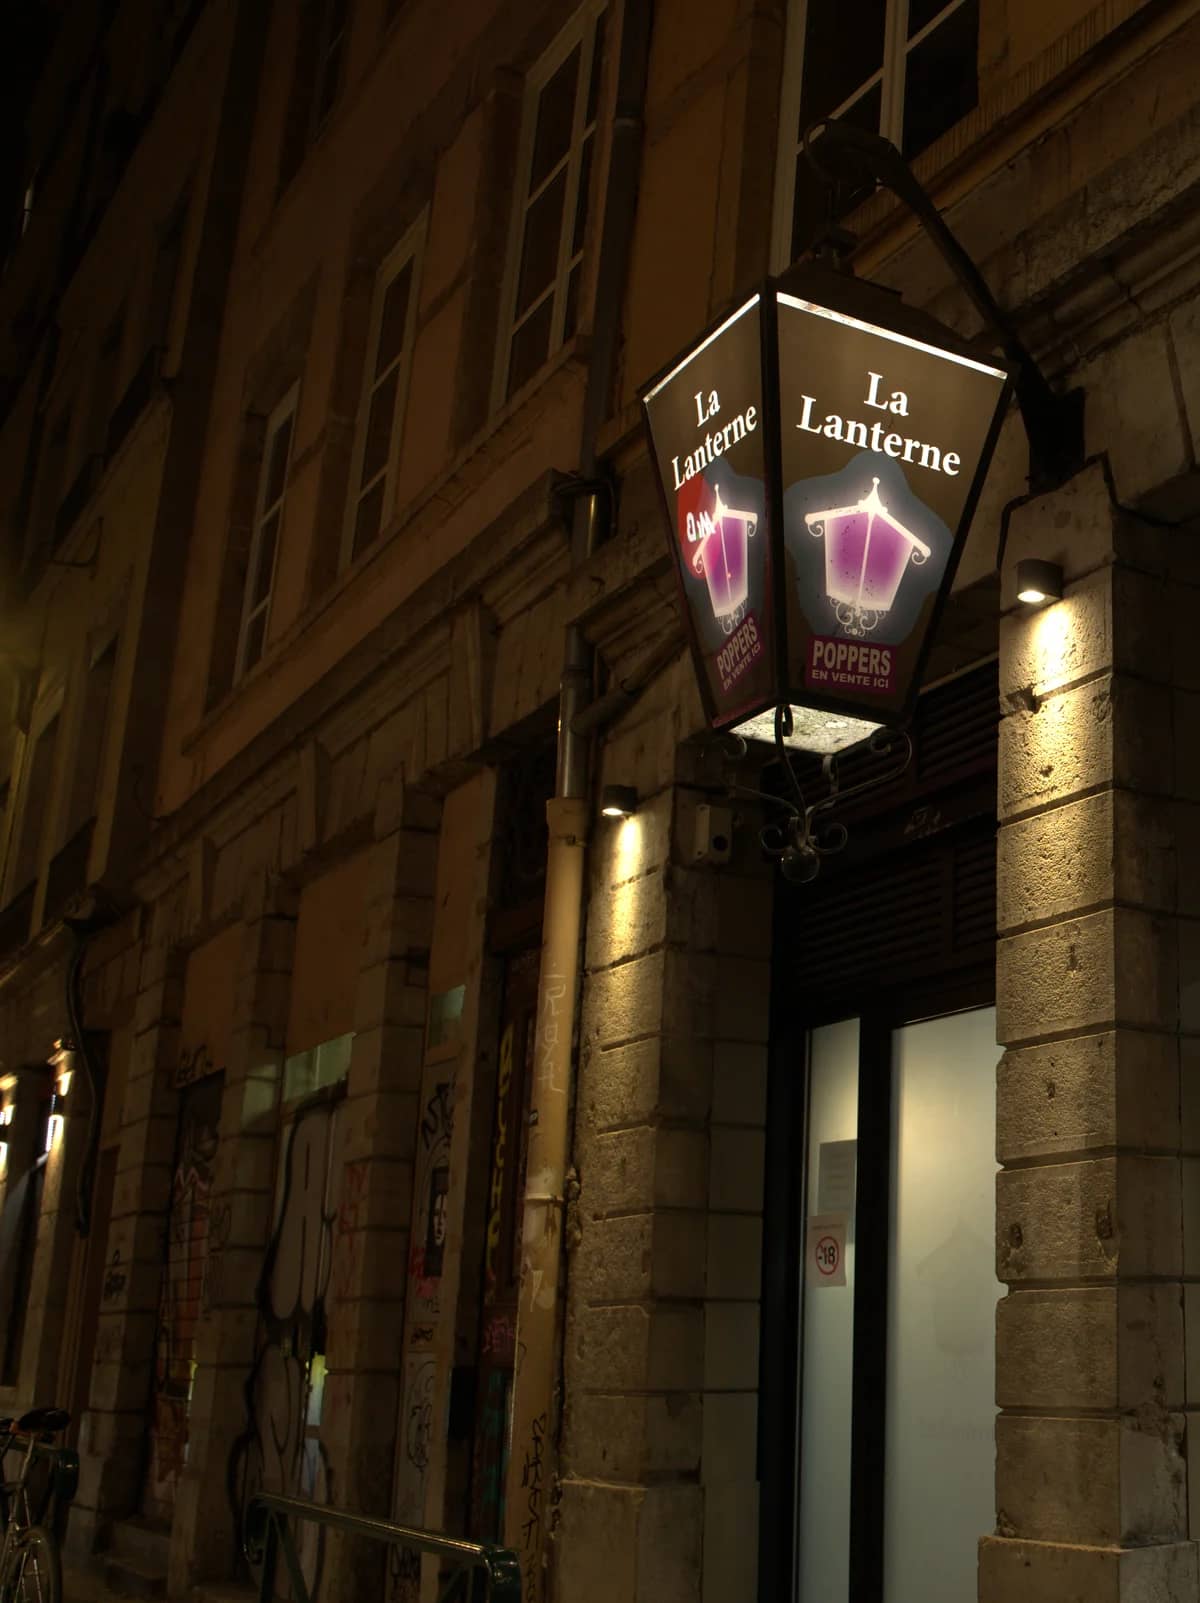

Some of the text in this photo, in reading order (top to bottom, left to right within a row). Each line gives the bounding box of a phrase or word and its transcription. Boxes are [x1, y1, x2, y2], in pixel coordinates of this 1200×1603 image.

[694, 389, 721, 427] La
[864, 371, 910, 417] La
[671, 405, 758, 491] Lanterne
[796, 395, 962, 477] Lanterne
[717, 617, 758, 680] POPPERS
[812, 639, 892, 676] POPPERS
[811, 669, 890, 689] EN VENTE ICI
